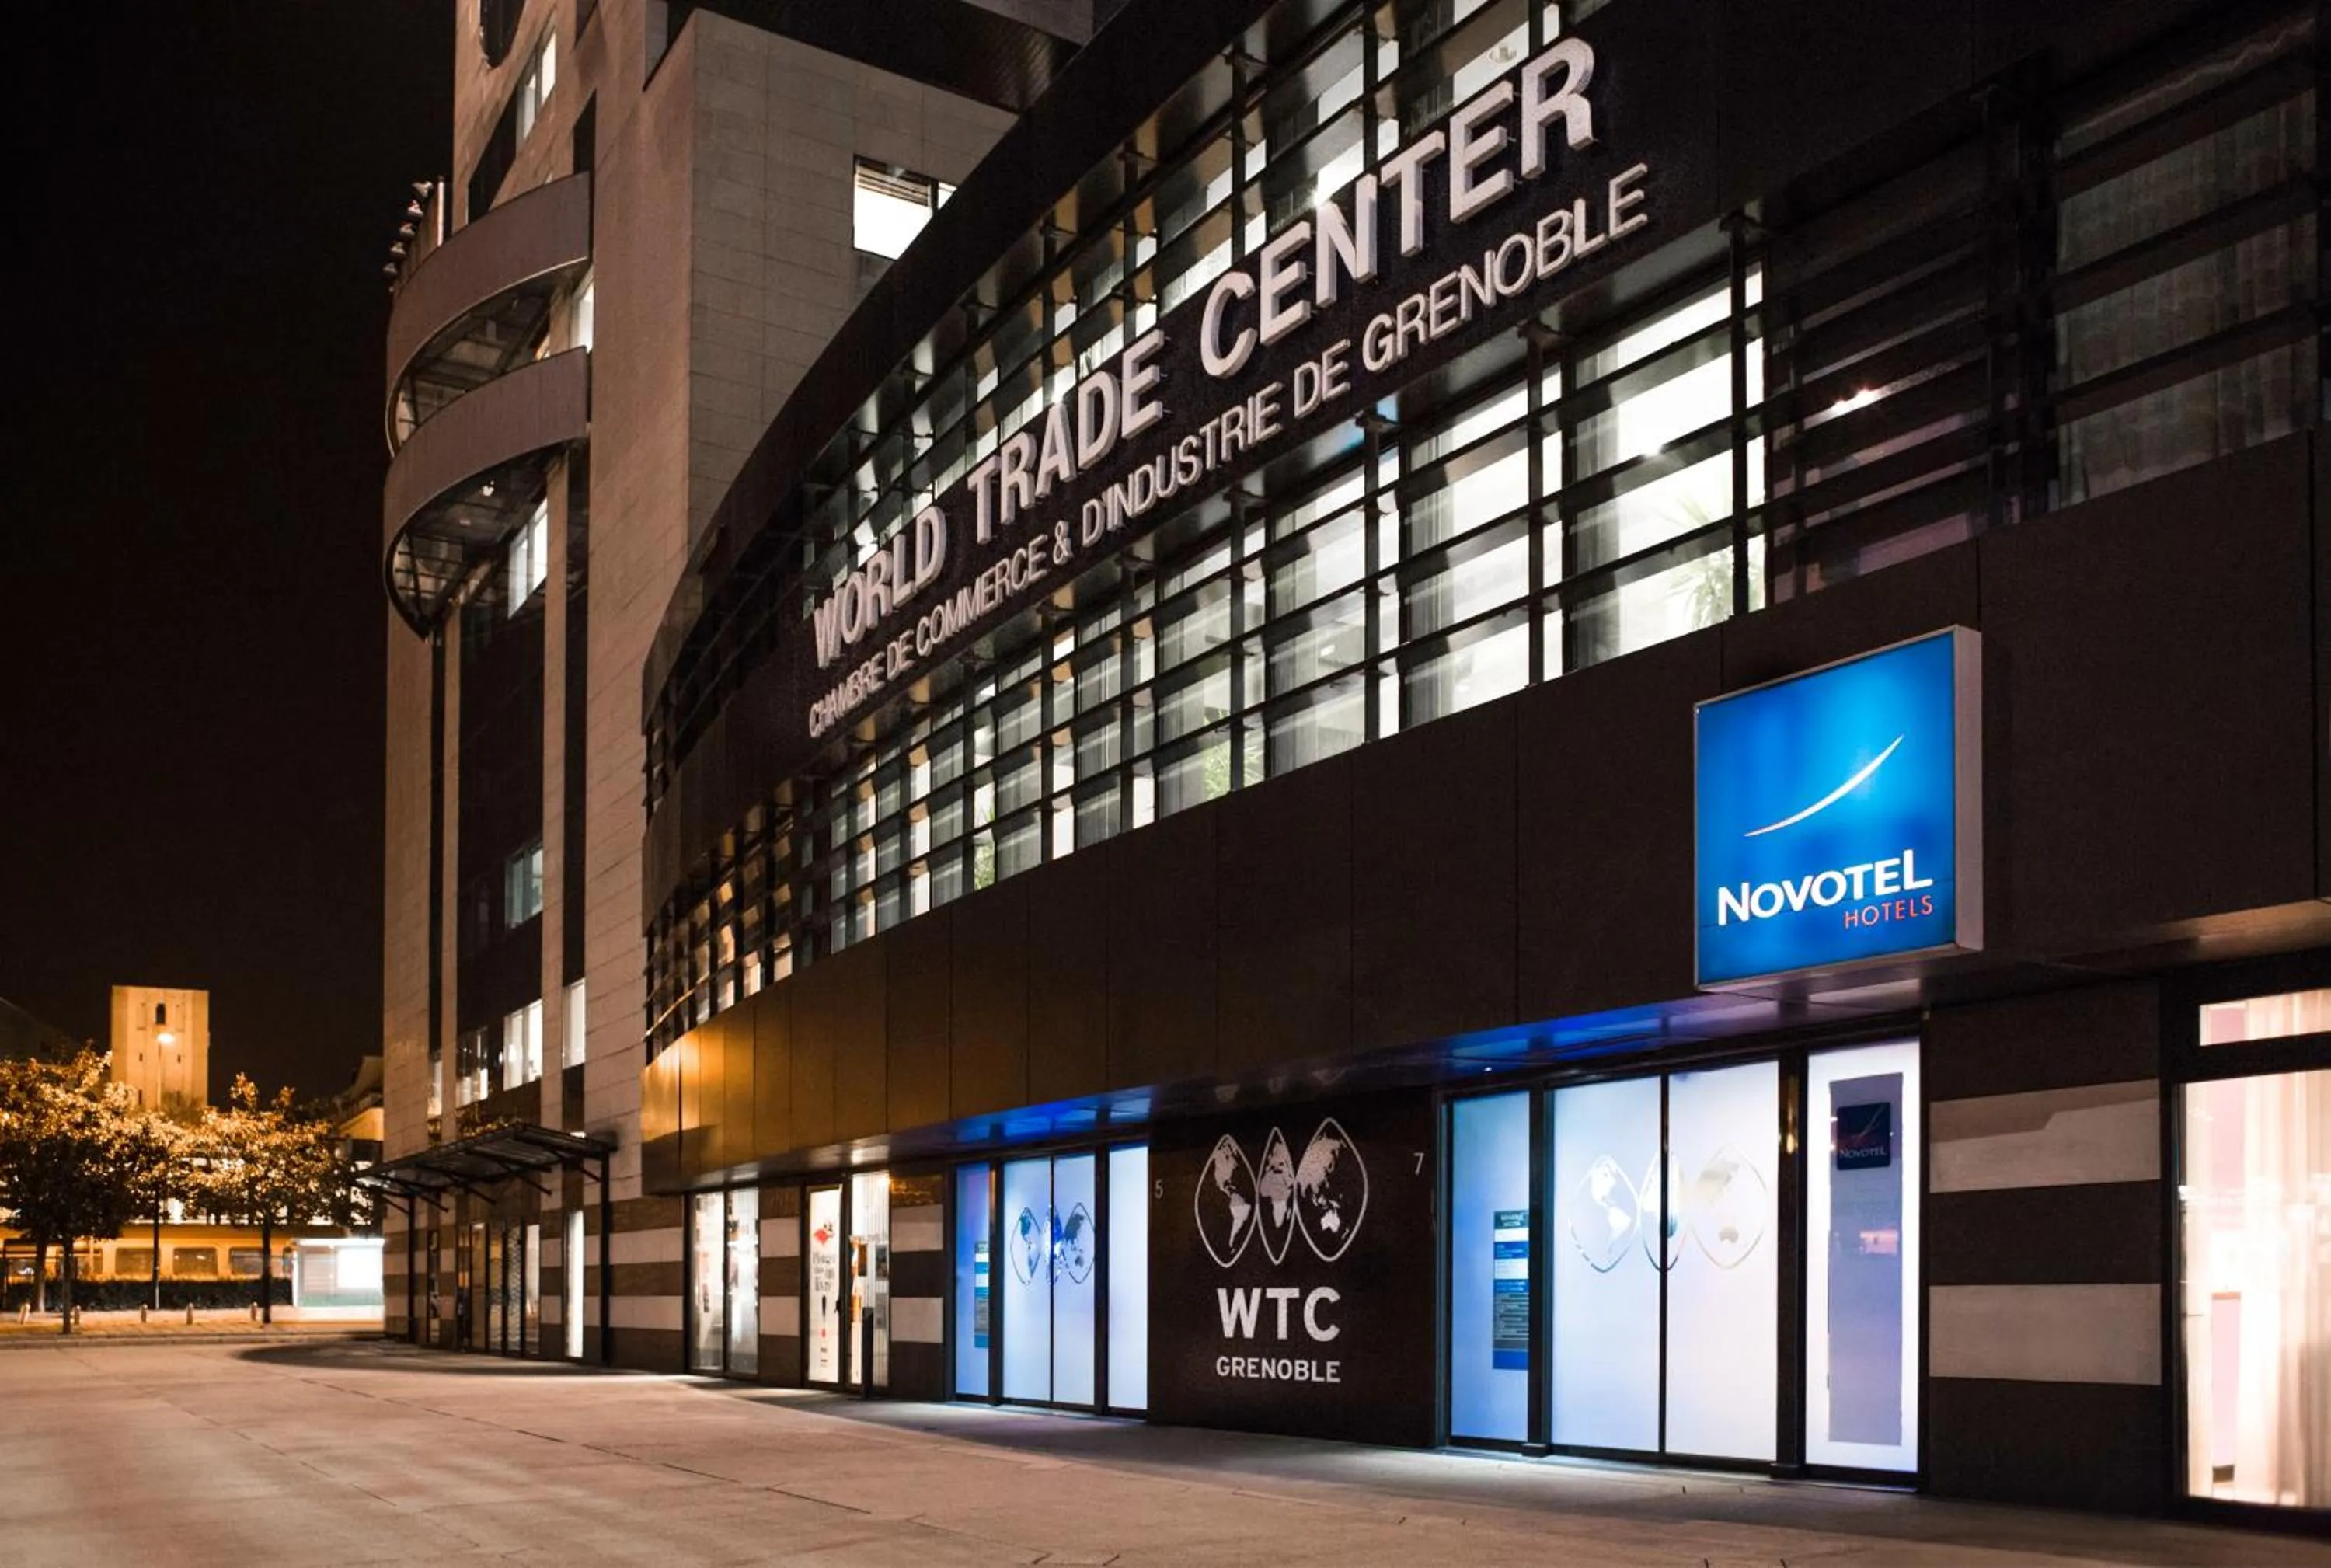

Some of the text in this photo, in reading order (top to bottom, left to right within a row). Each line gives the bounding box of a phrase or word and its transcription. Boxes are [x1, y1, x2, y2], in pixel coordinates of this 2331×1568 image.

[814, 37, 1595, 670] WORLD TRADE CENTER
[809, 162, 1649, 738] CHAMBRE DE COMMERCE & D'INDUSTRIE DE GRENOBLE
[1717, 848, 1934, 927] NOVOTEL
[1844, 894, 1934, 929] HOTELS
[1413, 1152, 1425, 1176] 7
[1839, 1145, 1887, 1159] NOVOTEL
[1155, 1179, 1164, 1200] 5
[1217, 1285, 1342, 1343] WTC
[1216, 1355, 1341, 1383] GRENOBLE
